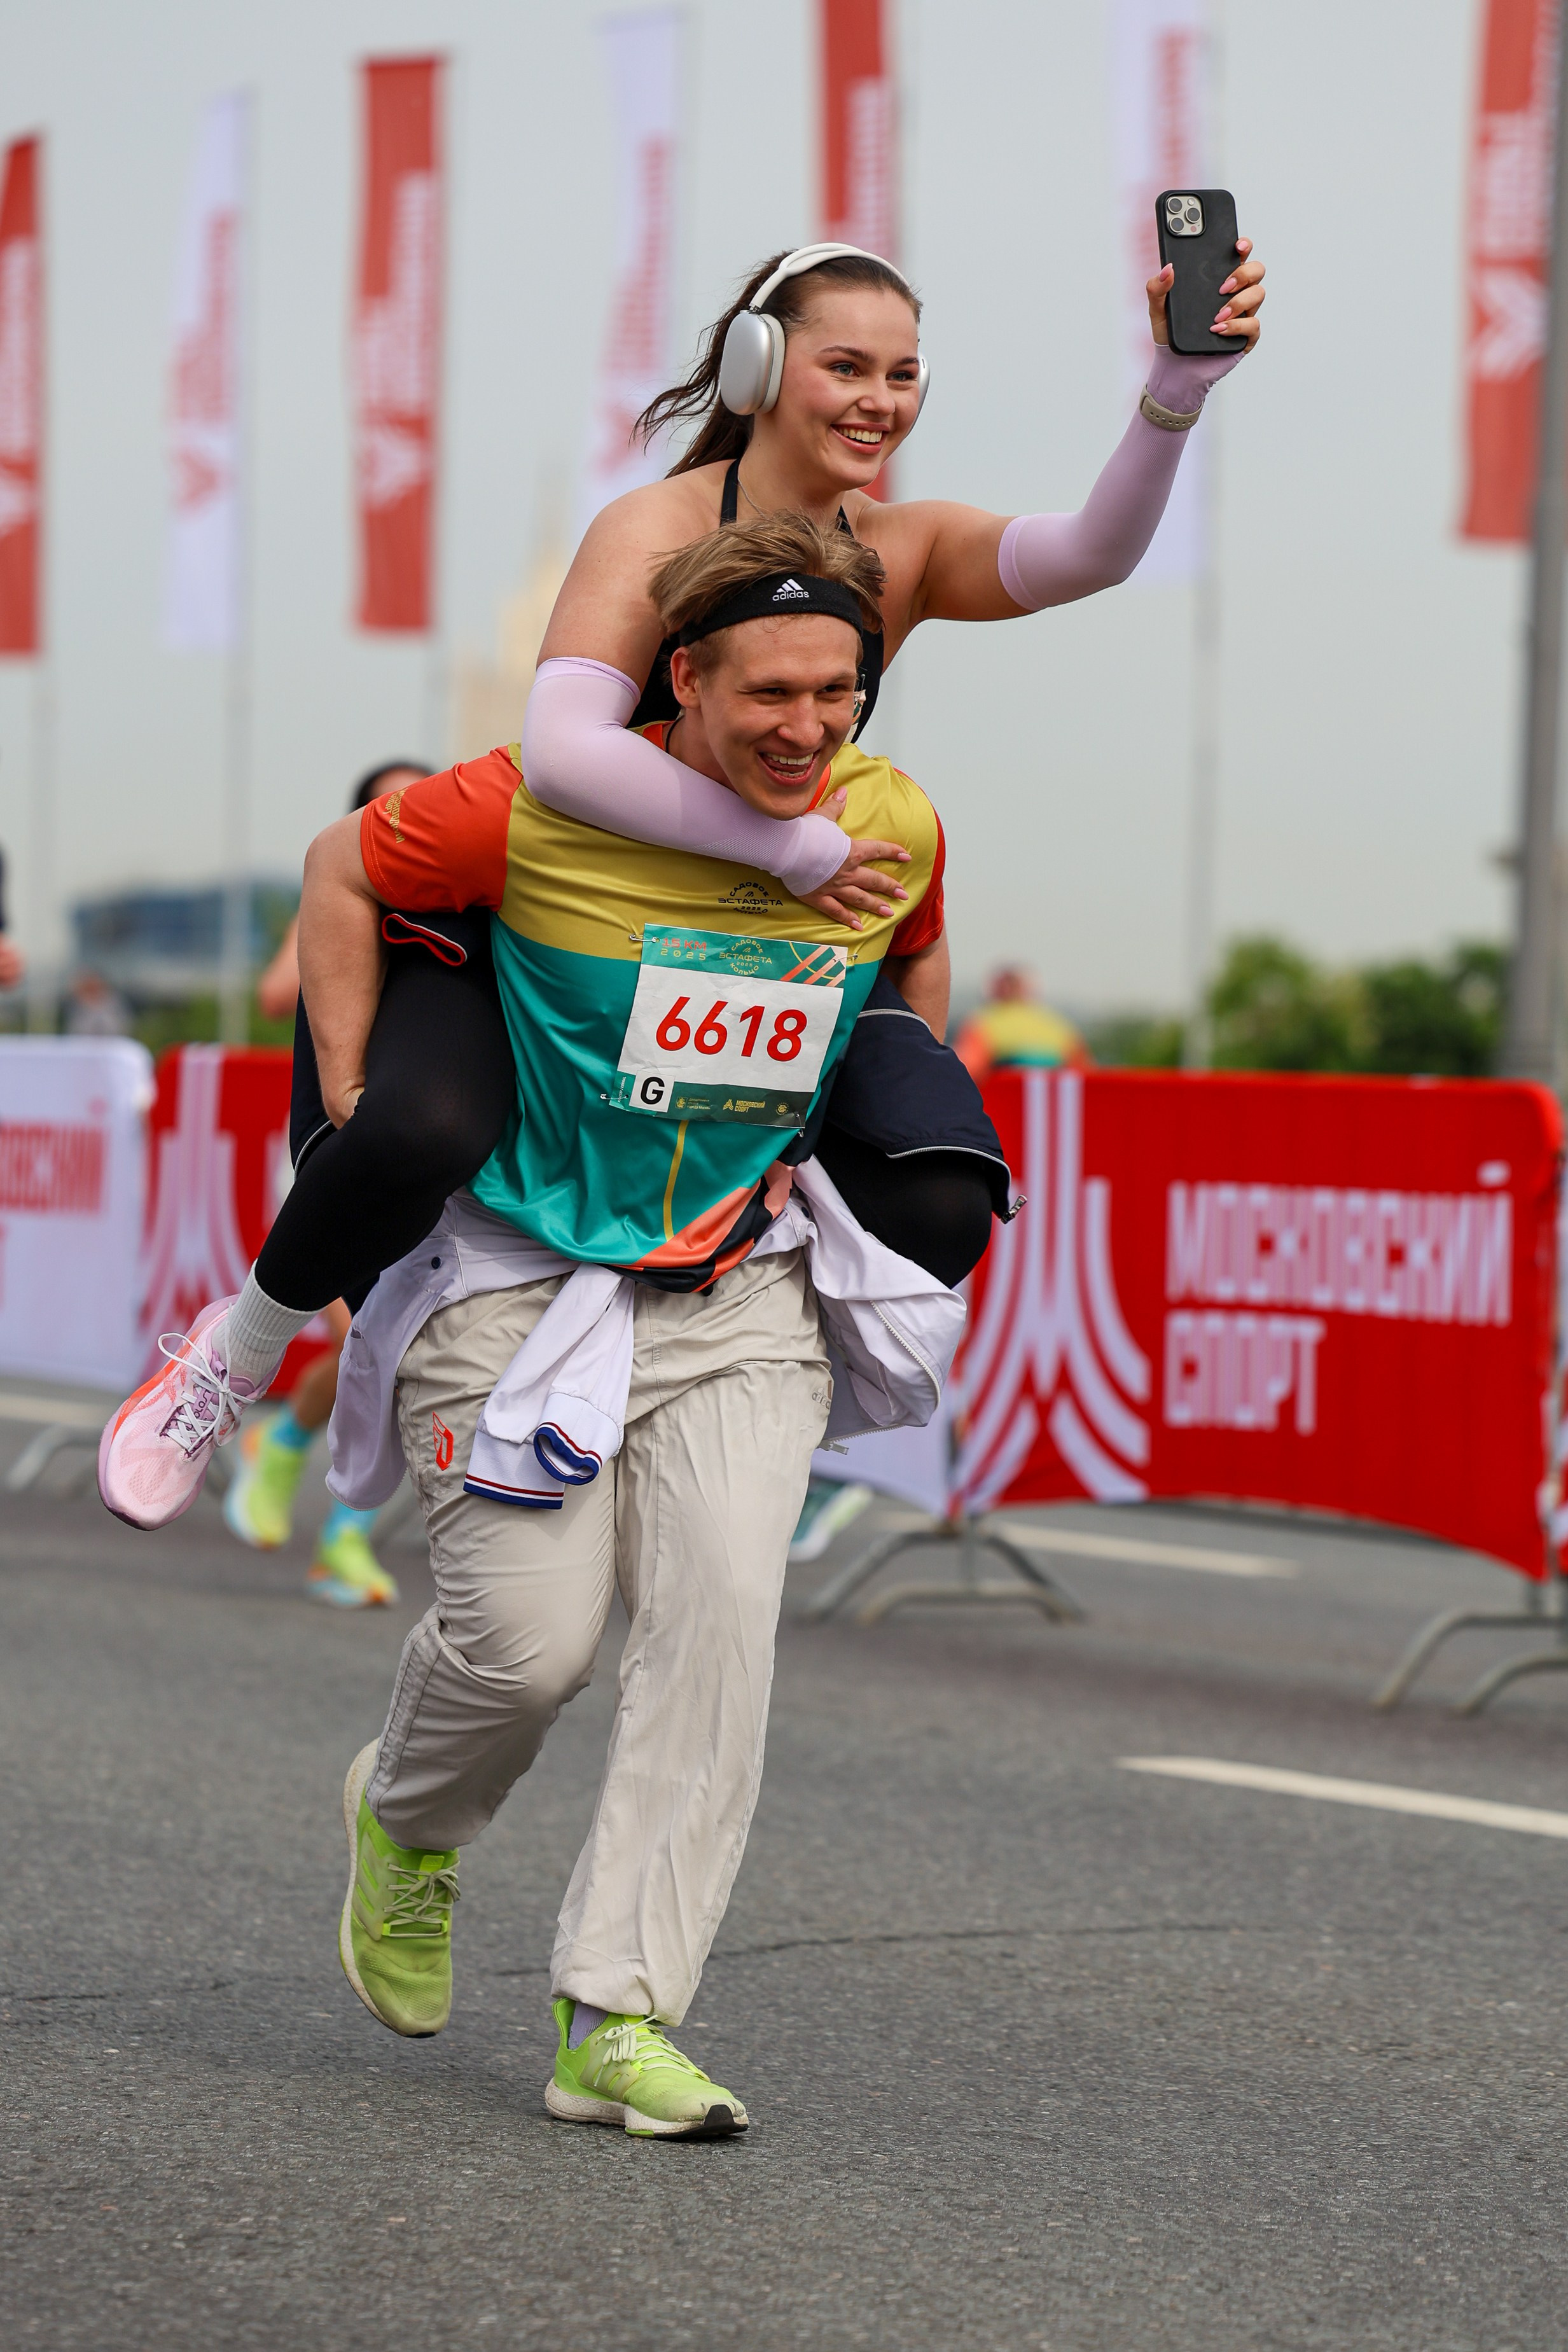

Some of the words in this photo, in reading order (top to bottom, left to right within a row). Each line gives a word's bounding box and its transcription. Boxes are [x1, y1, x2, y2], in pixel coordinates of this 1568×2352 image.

[772, 590, 810, 601] adidas
[730, 882, 769, 897] САДОВОЕ
[718, 898, 784, 906] ЭСТАФЕТА
[662, 938, 681, 948] 15
[732, 938, 763, 954] САДОВОЕ
[660, 948, 706, 961] 2025
[719, 952, 772, 964] ЭСТАФЕТА
[730, 963, 759, 975] КОЛЬЦО
[656, 996, 807, 1062] 6618
[641, 1076, 665, 1105] G
[1167, 1160, 1511, 1327] МОСКОВСКИЙ
[1165, 1311, 1325, 1435] СПОРТ
